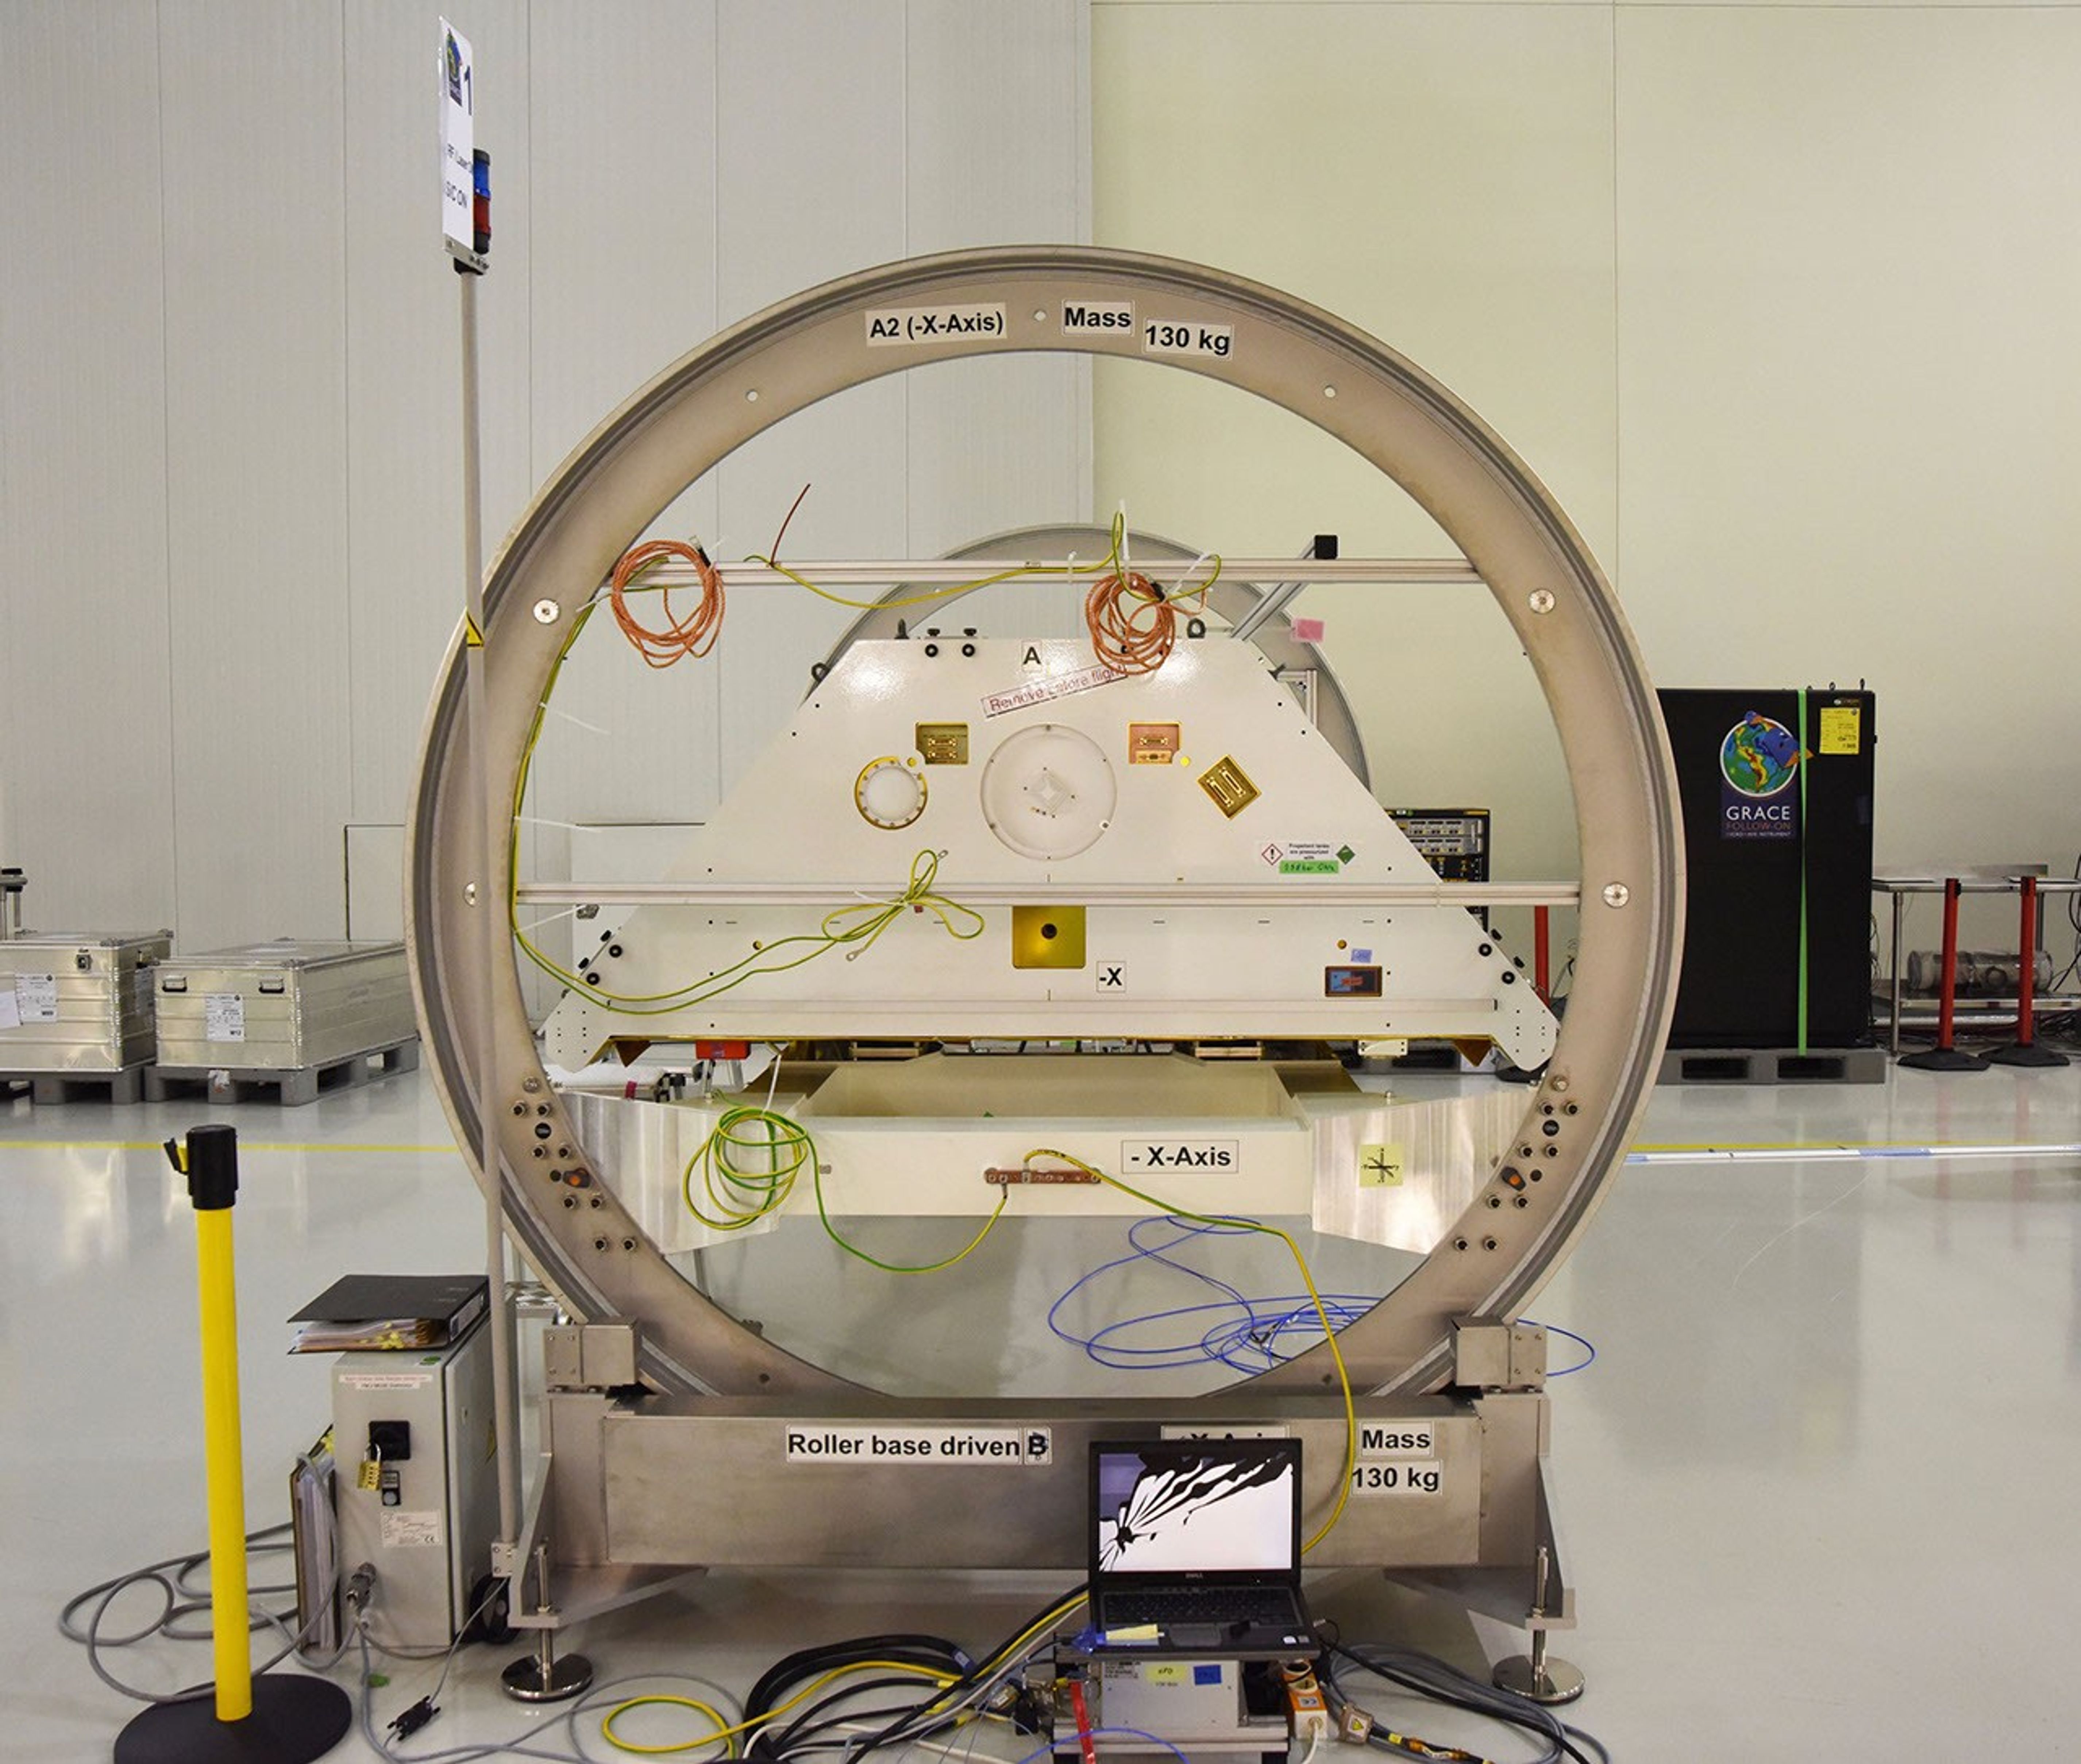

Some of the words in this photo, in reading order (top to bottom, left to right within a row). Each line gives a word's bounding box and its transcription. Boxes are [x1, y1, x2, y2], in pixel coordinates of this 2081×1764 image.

[870, 318, 900, 338] A2
[907, 311, 1003, 340] (-X-Axis)
[1065, 307, 1132, 327] Mass
[1146, 326, 1190, 347] 130
[1199, 330, 1230, 356] kg
[1023, 646, 1041, 665] A
[1726, 806, 1791, 820] GRACE
[1099, 967, 1122, 986] -X
[1147, 1147, 1231, 1166] X-Axis
[789, 1434, 864, 1454] Roller
[872, 1435, 931, 1455] base
[941, 1436, 1020, 1456] driven
[1363, 1430, 1430, 1449] Mass
[1352, 1468, 1398, 1488] 130
[1408, 1468, 1438, 1492] kg
